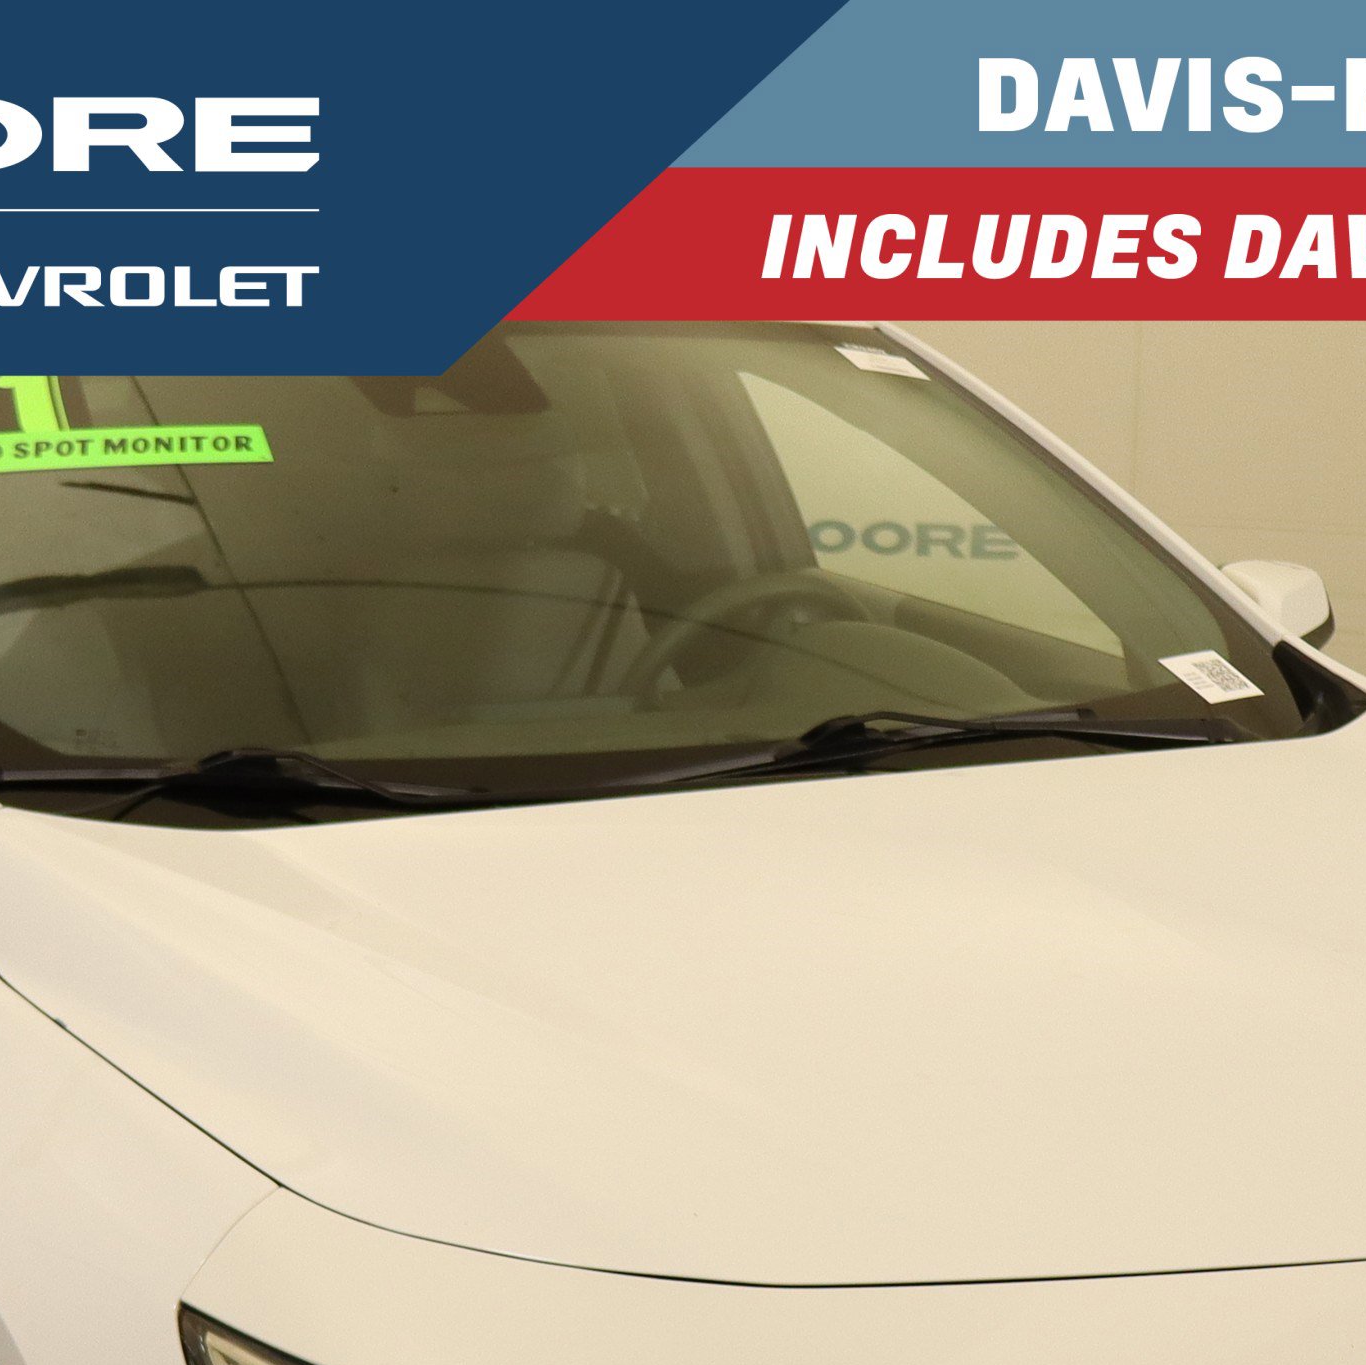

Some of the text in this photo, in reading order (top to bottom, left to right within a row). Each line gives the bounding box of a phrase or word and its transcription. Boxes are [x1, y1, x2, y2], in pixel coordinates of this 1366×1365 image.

[13, 438, 95, 460] SPOT
[103, 434, 256, 457] MONITOR
[807, 519, 1020, 561] OORE
